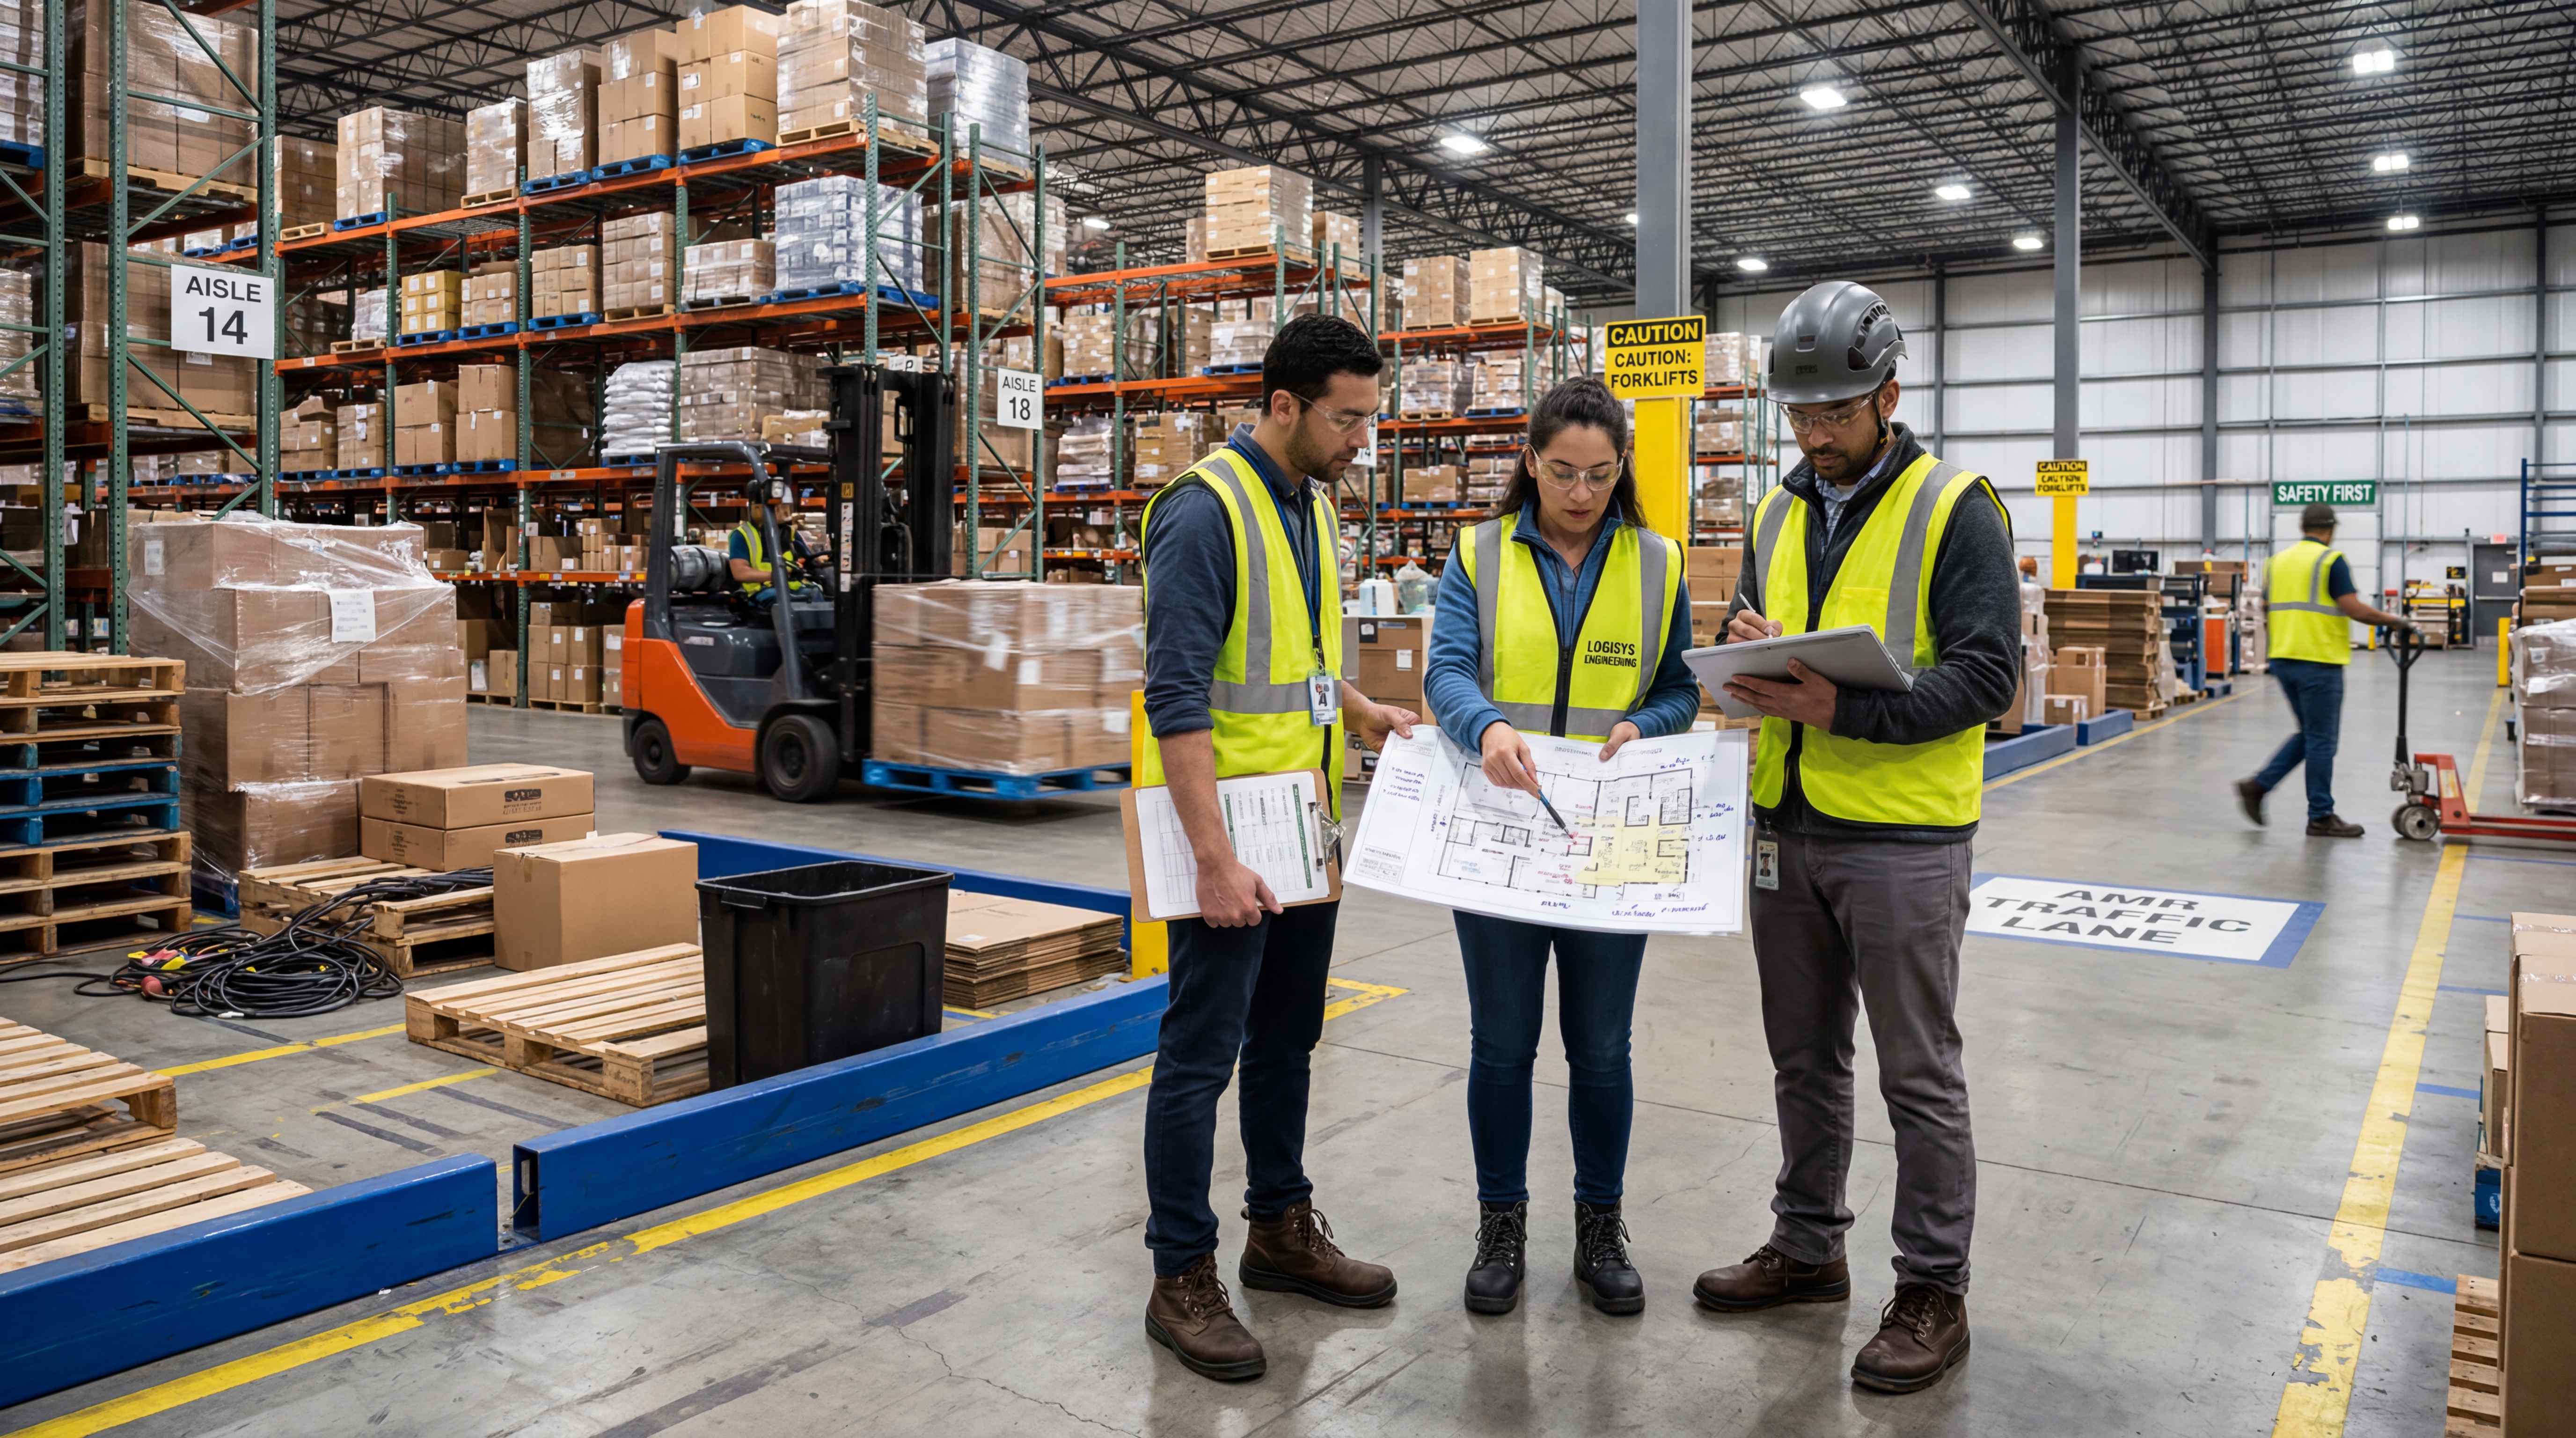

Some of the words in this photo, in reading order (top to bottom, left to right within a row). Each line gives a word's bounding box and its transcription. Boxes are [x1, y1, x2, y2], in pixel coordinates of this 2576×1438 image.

[185, 276, 261, 303] AISLE
[199, 307, 248, 345] 14
[1611, 322, 1698, 345] CAUTION
[1615, 349, 1691, 367] CAUTION:
[1002, 376, 1036, 393] AISLE
[1611, 370, 1698, 389] FORKLIFTS
[1009, 396, 1031, 420] 18
[2039, 462, 2086, 471] CAUTION
[2277, 484, 2330, 502] SAFETY
[2333, 484, 2372, 501] FIRST
[1587, 640, 1635, 655] LOGISYS
[1584, 655, 1637, 668] ENGINEERING
[2055, 889, 2199, 910] AMR
[1985, 896, 2252, 932] TRAFFIC
[2000, 916, 2182, 944] LANE
